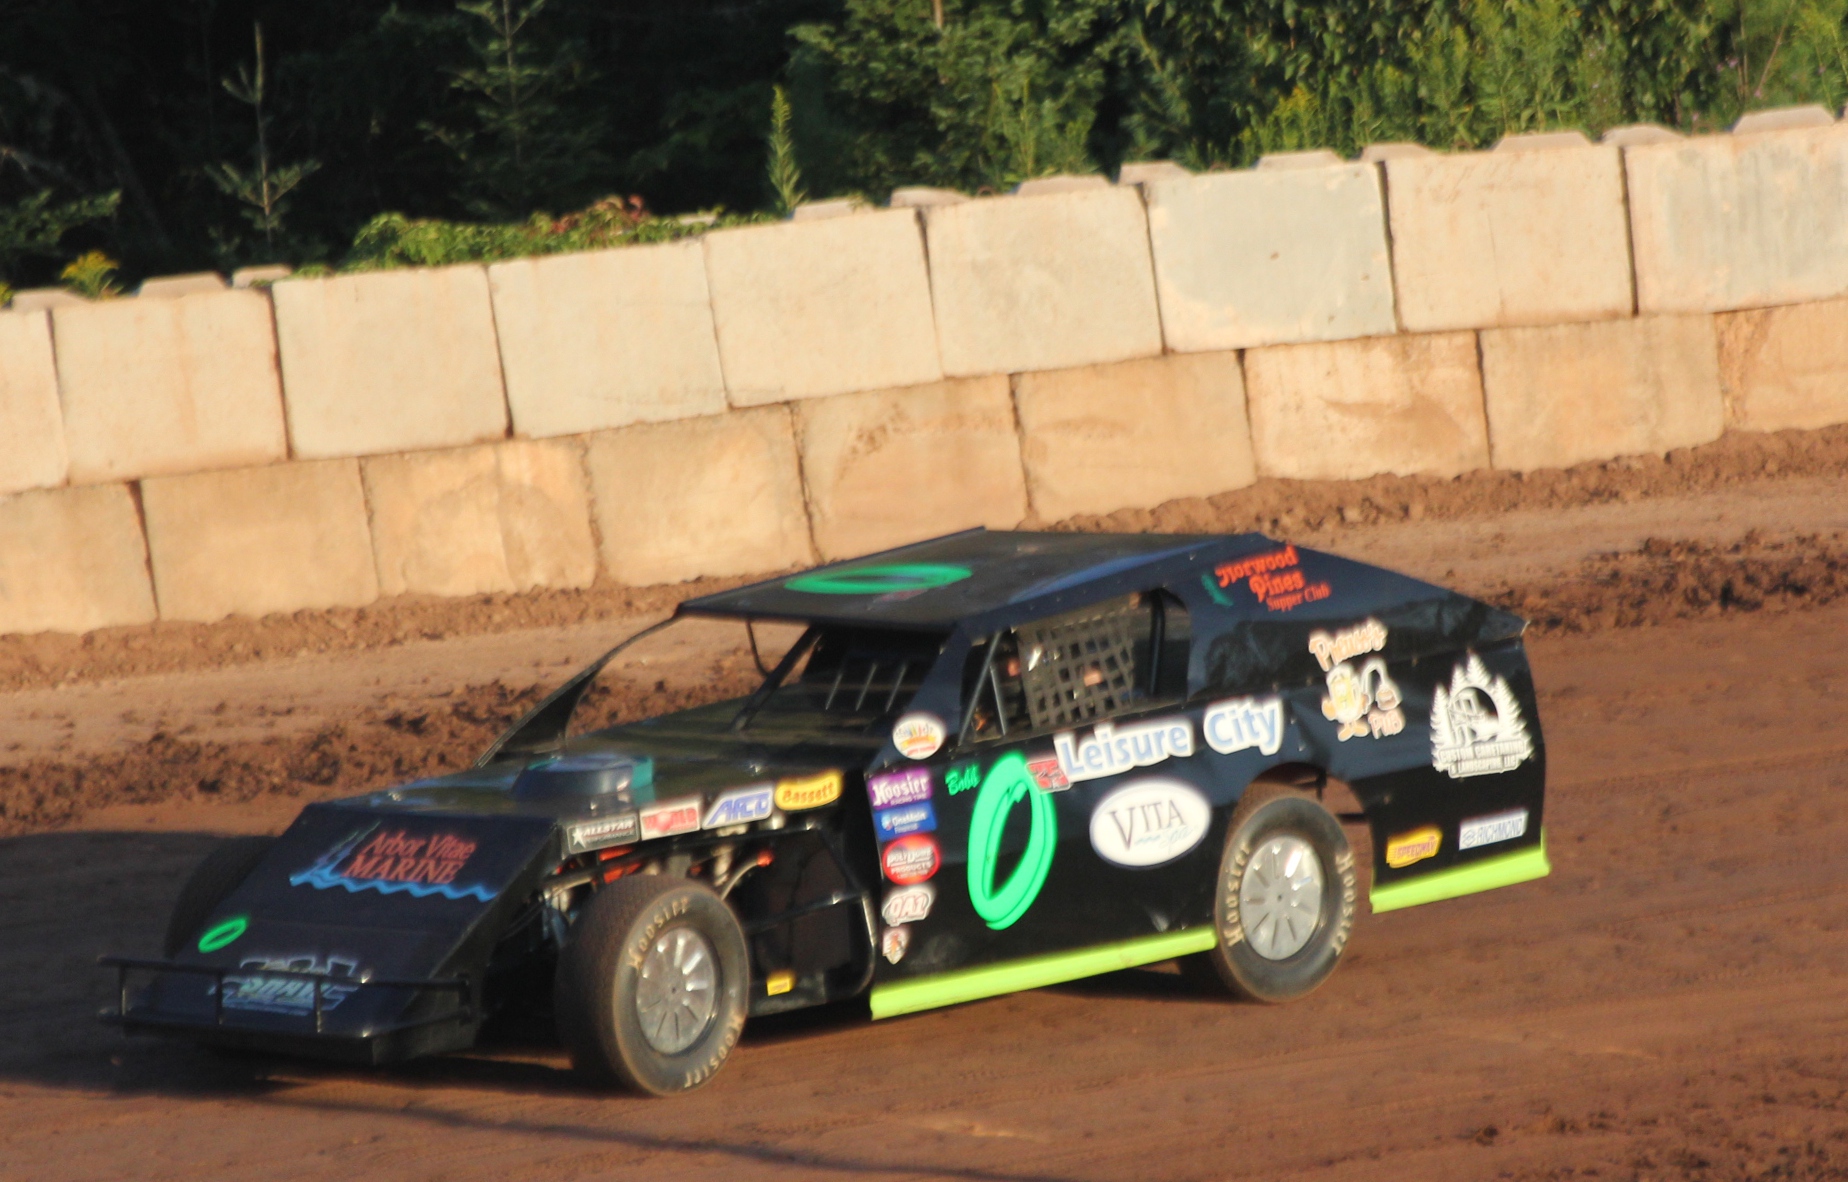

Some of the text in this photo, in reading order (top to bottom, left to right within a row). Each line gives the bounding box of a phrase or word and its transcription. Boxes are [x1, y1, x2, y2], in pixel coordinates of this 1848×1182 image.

[1215, 545, 1299, 588] Norwood
[1249, 571, 1305, 603] Pines
[1266, 581, 1331, 611] Supper Club
[1059, 724, 1189, 775] Leisure
[1206, 705, 1279, 751] City
[782, 782, 834, 803] Bassett
[872, 774, 928, 806] Hoosier
[706, 792, 769, 826] AFCO
[583, 820, 634, 837] ALLSTAR
[967, 751, 1057, 930] 0
[1108, 799, 1186, 852] VITA
[1476, 817, 1522, 844] RICHMOND
[360, 830, 476, 860] Arbor Vitae
[340, 855, 466, 884] MARINE
[889, 893, 927, 922] QA1
[1224, 842, 1250, 947] Hoosier
[1332, 852, 1355, 956] Hoosier
